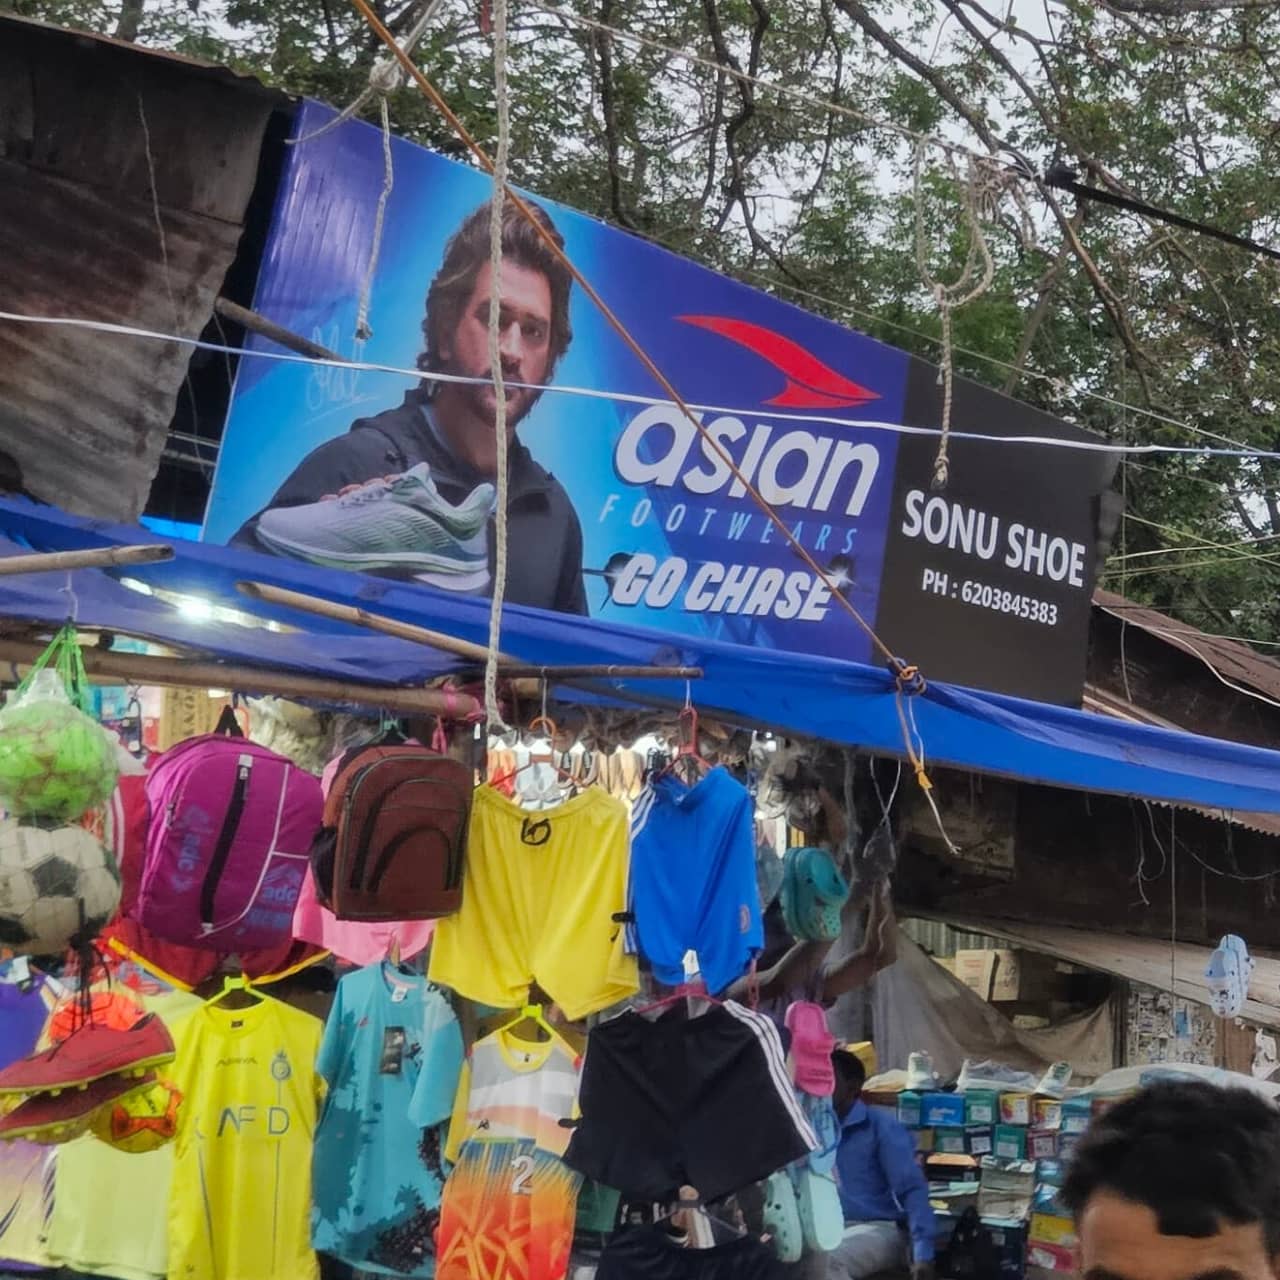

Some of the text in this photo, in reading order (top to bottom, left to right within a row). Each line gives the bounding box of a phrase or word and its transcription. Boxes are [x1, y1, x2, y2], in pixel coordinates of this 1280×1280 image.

[614, 404, 880, 517] asian
[599, 493, 858, 554] FOOTWEARS
[902, 489, 1086, 587] SONU SHOE
[611, 553, 840, 621] GO CHASE
[922, 568, 948, 596] PH
[961, 580, 1058, 625] 6203845383
